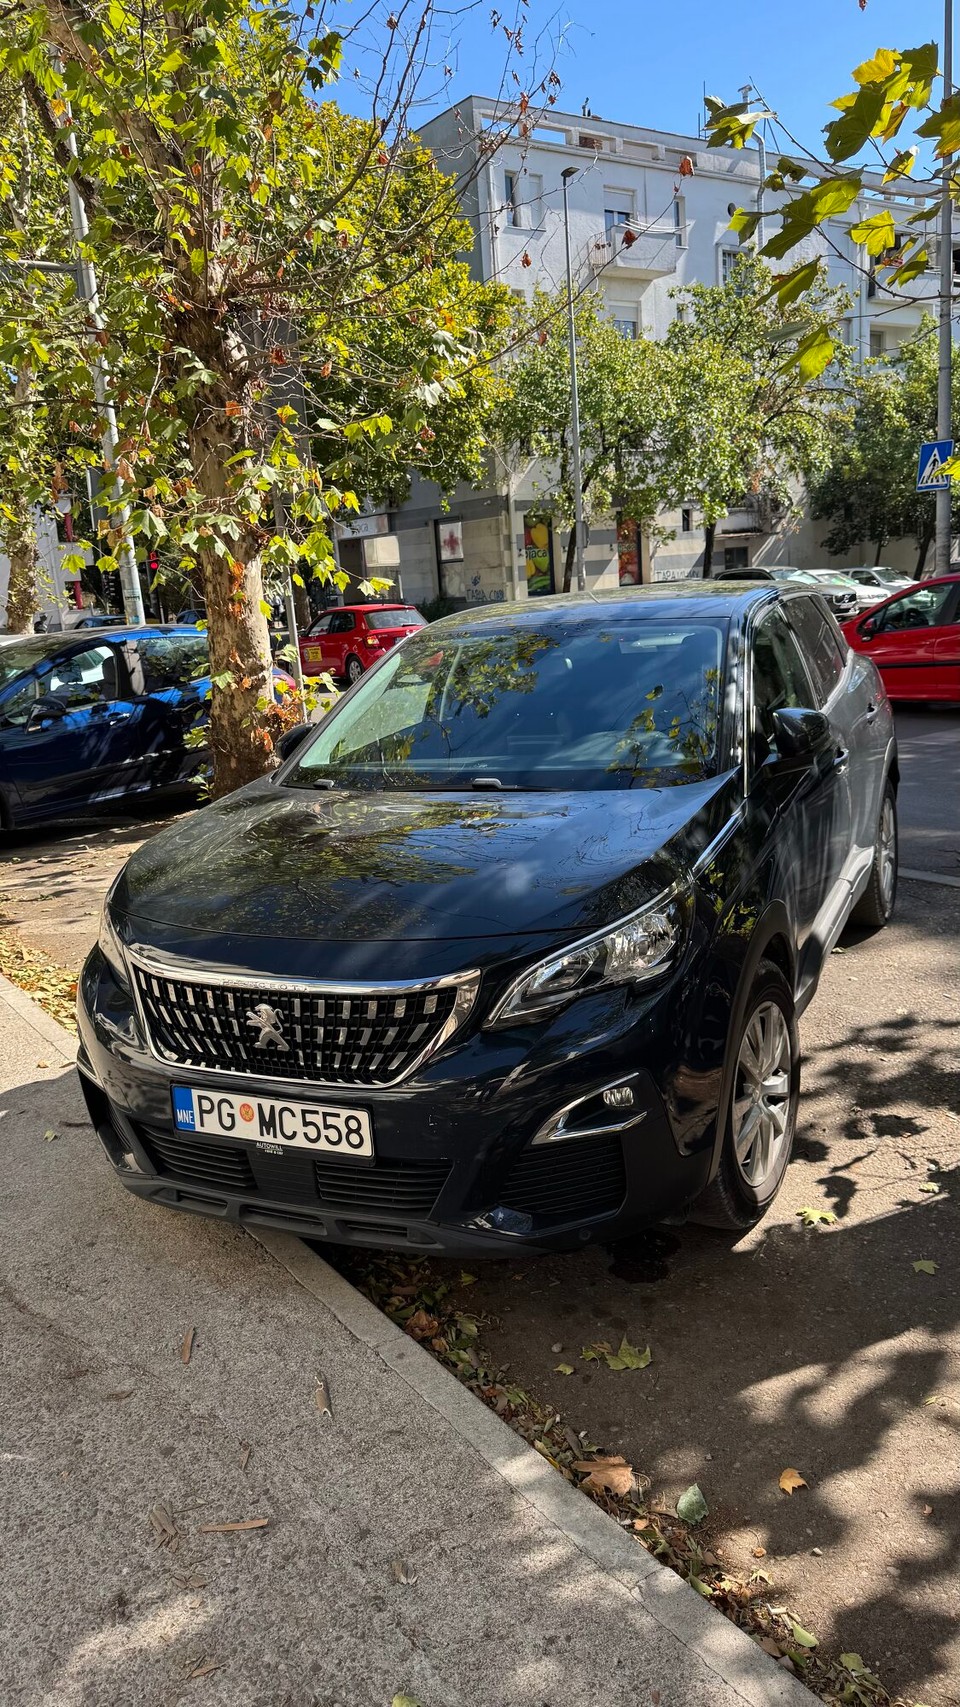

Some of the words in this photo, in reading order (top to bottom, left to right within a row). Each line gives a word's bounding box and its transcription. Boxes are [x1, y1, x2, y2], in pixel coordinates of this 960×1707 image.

[176, 1108, 195, 1125] MNE
[197, 1094, 236, 1132] PG
[257, 1102, 364, 1149] MC558
